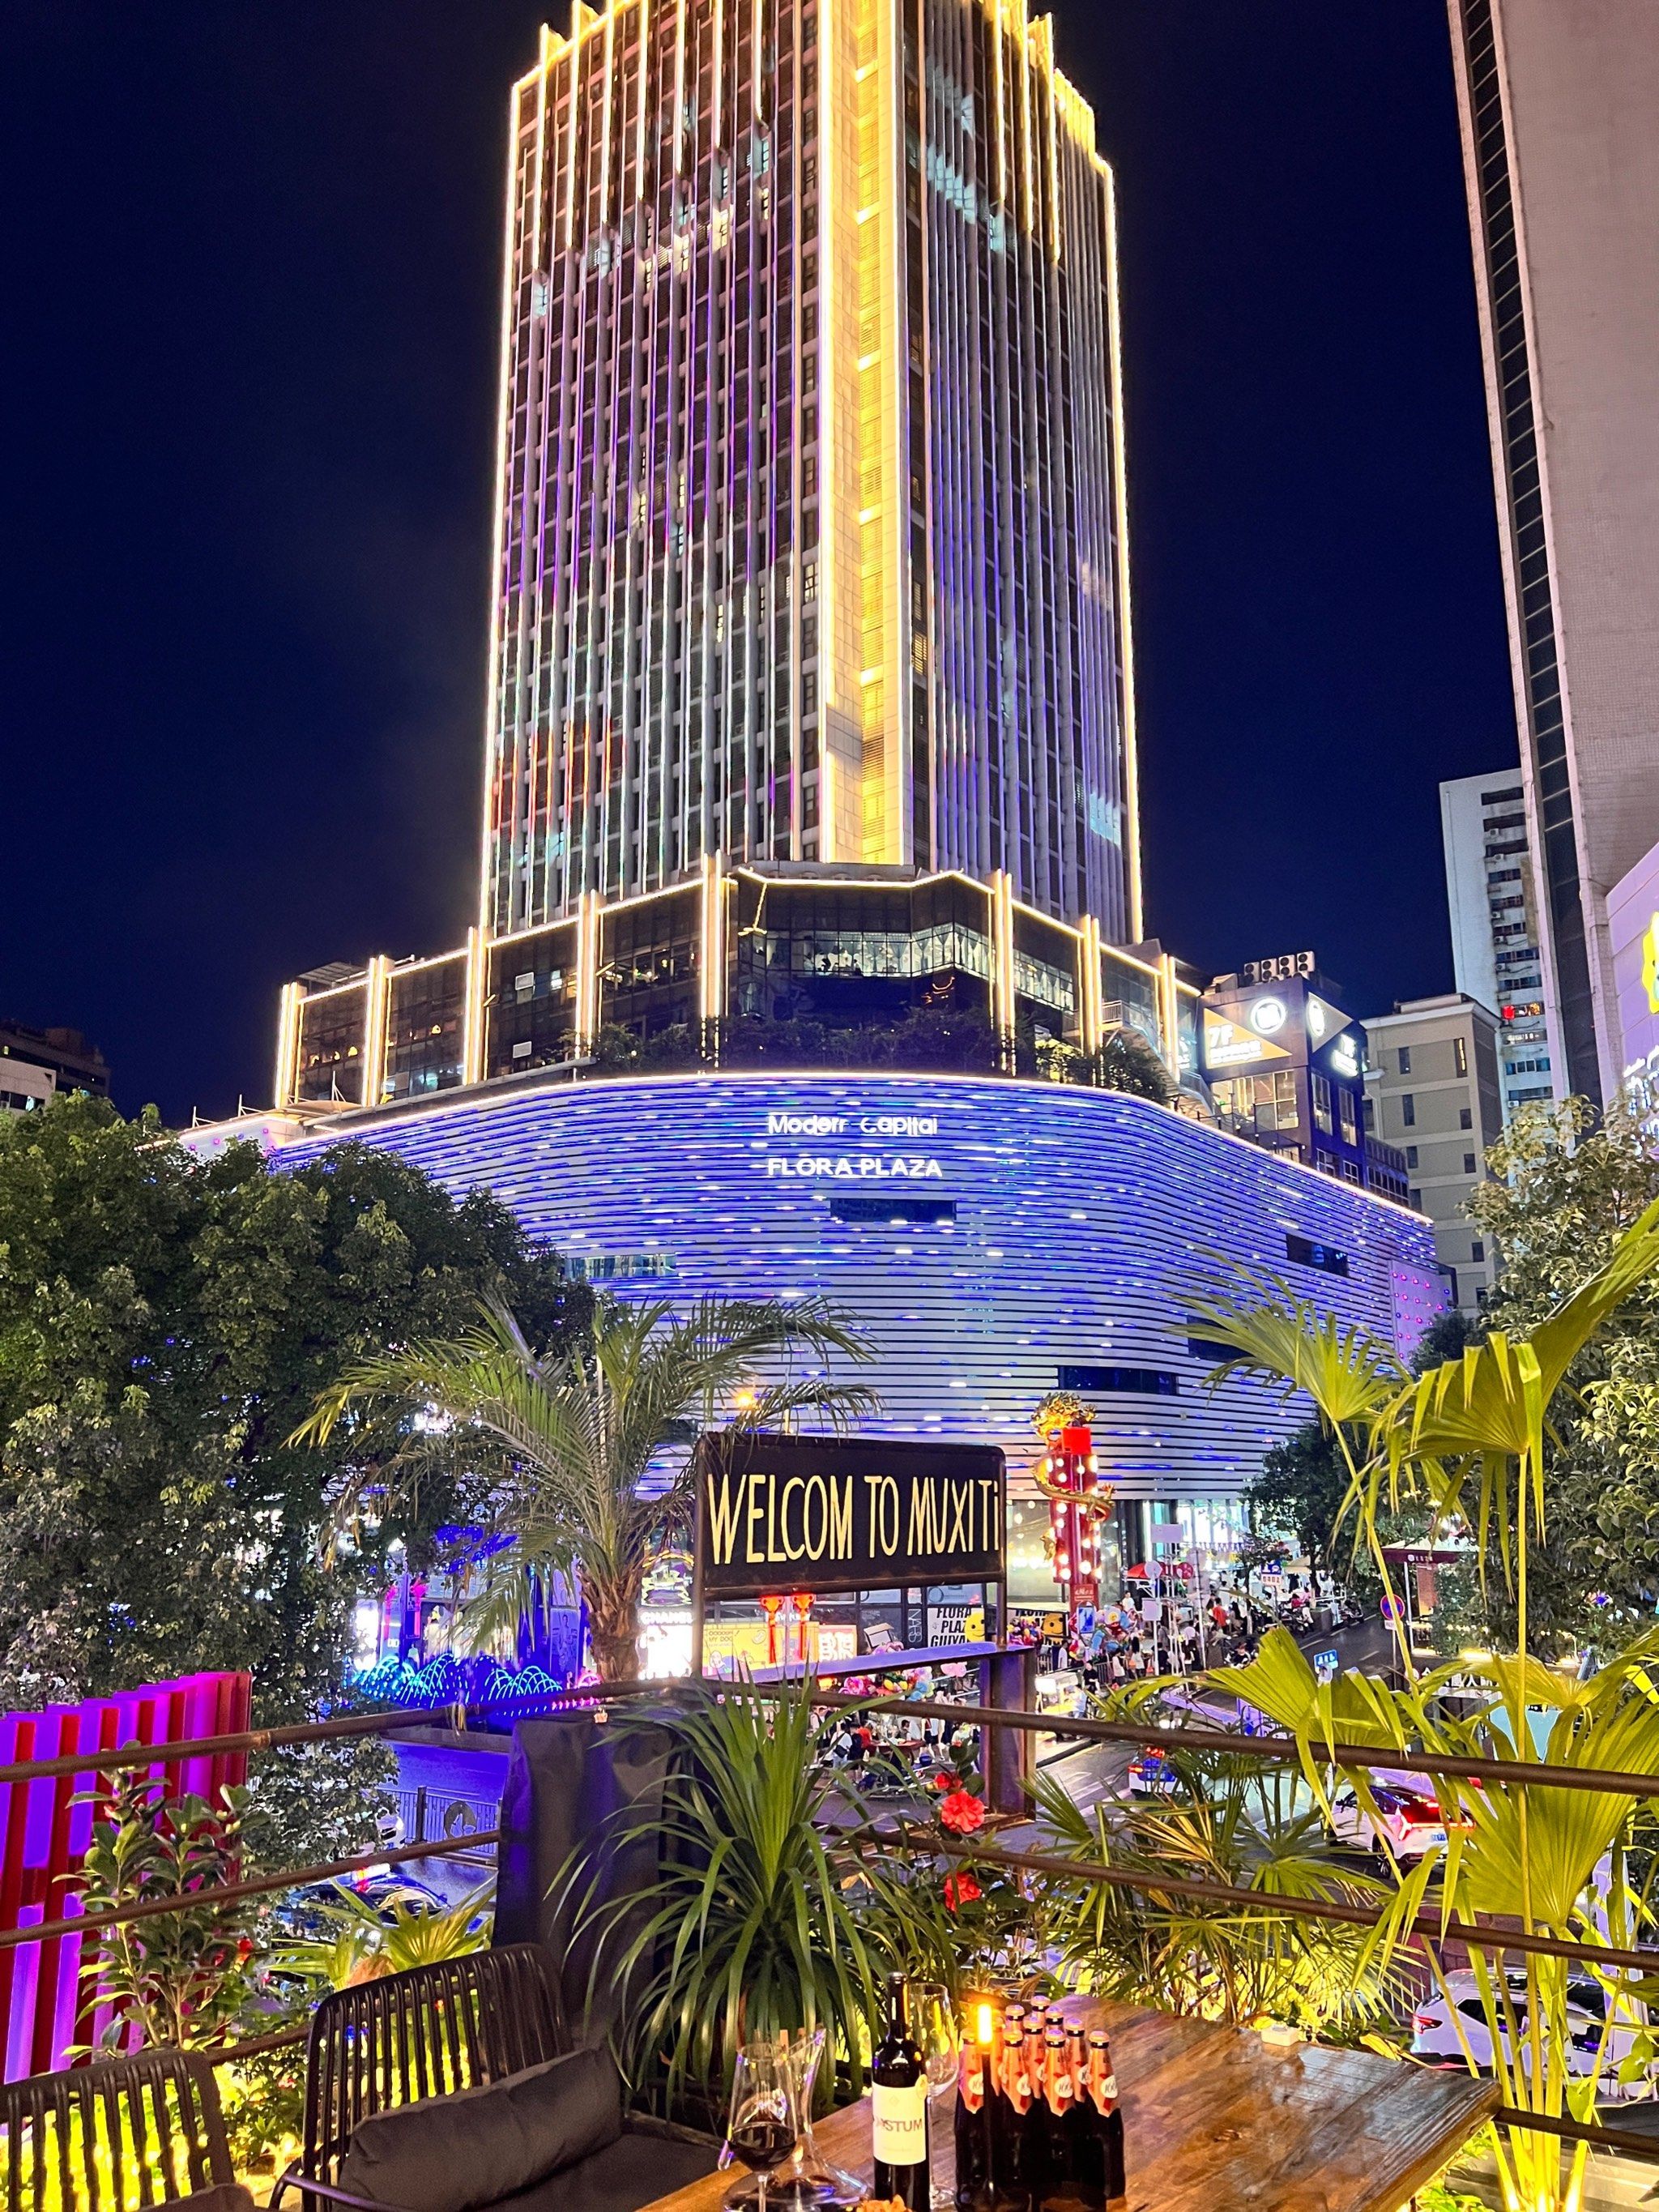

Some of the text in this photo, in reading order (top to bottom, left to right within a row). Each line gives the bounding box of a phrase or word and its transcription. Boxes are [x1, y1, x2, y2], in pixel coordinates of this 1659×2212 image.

[768, 1158, 943, 1177] FLORA PLAZA
[707, 1473, 854, 1565] WELCOM
[864, 1475, 900, 1558] TO
[907, 1608, 923, 1643] NARS
